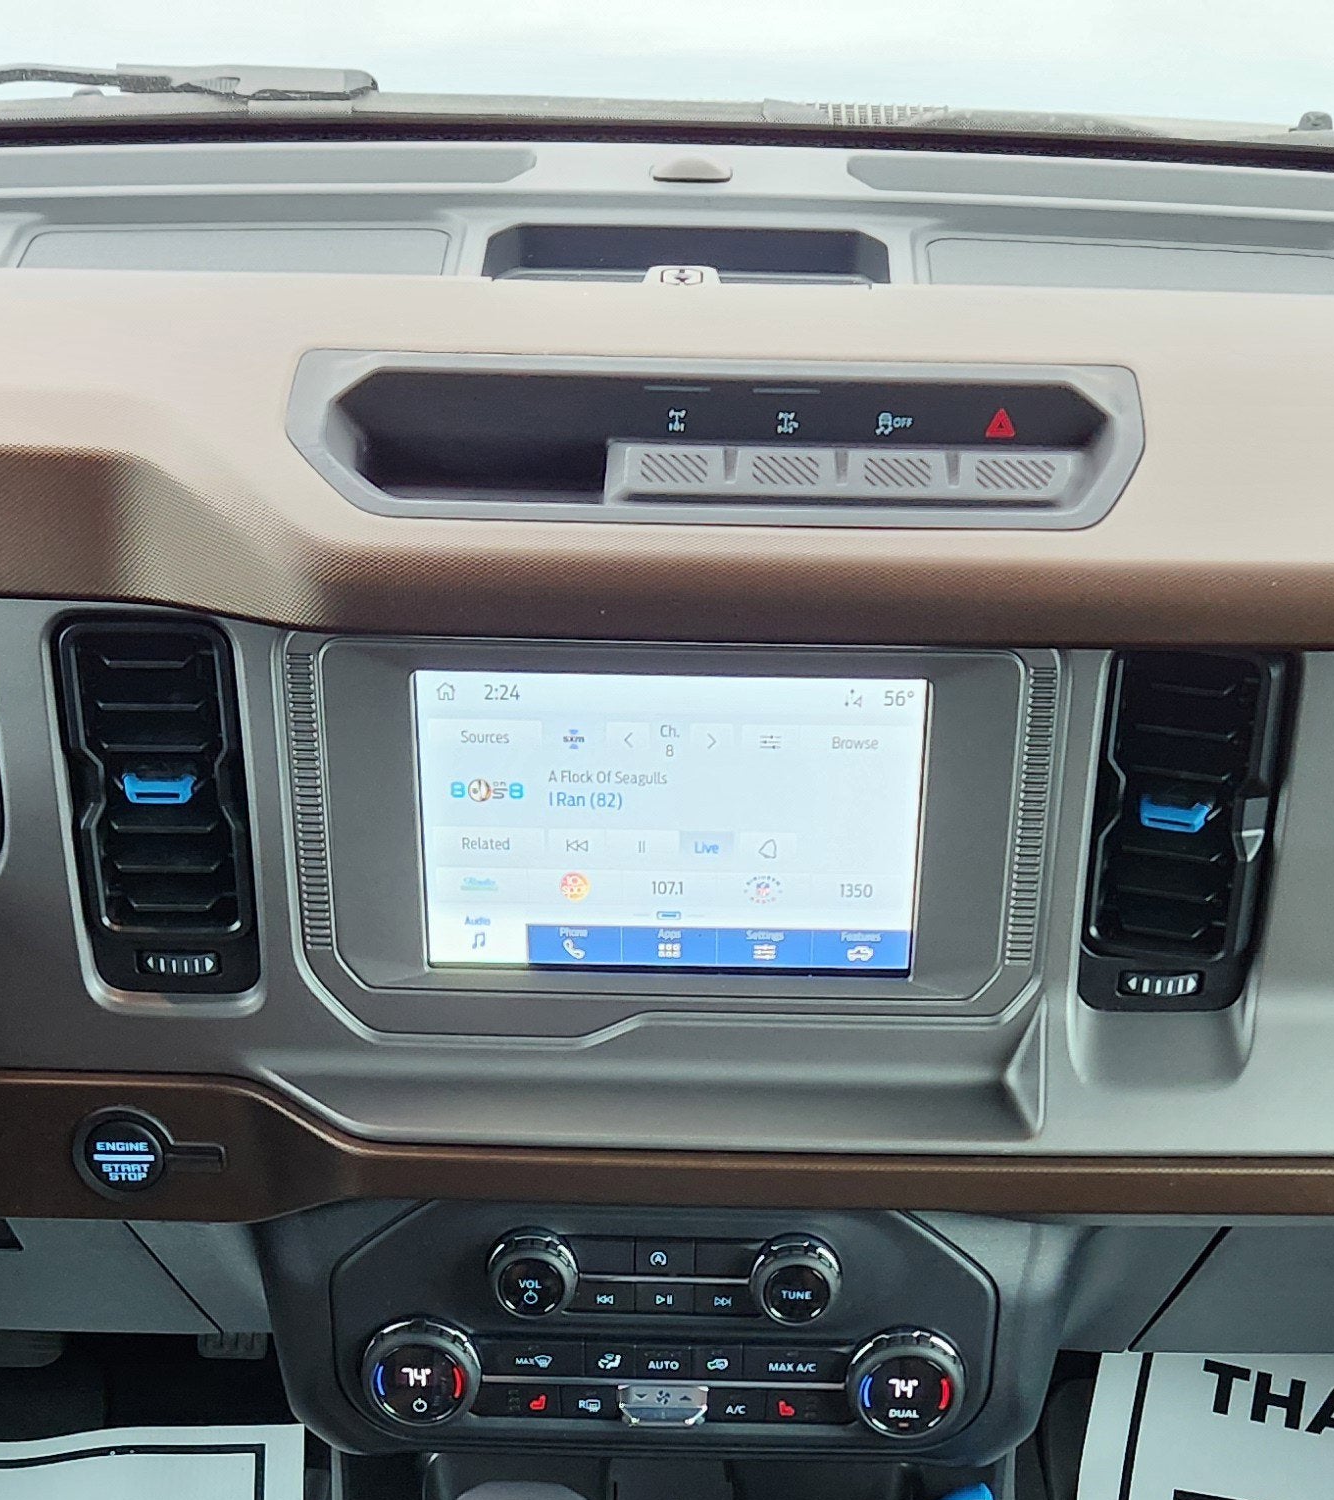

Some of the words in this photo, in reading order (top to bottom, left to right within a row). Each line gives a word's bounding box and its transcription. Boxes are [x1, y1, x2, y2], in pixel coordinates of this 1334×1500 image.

[893, 416, 914, 429] OFF
[484, 684, 520, 700] 2:24
[883, 690, 916, 707] 56°
[460, 730, 510, 745] Sources
[659, 724, 681, 739] Ch.
[831, 735, 880, 750] Browse
[665, 744, 675, 758] 8
[547, 770, 558, 783] A
[560, 770, 593, 784] Flock
[596, 770, 612, 784] Of
[614, 770, 667, 787] Seagulls
[556, 791, 585, 807] Ran
[590, 791, 623, 811] (82)
[461, 836, 511, 851] Related
[694, 841, 720, 855] Live
[651, 880, 685, 896] 107.1
[839, 883, 874, 899] 1350
[464, 915, 491, 926] Audio
[558, 926, 589, 938] Phone
[656, 928, 683, 941] Apps
[95, 1141, 149, 1152] ENGINE
[102, 1163, 150, 1173] START
[108, 1172, 147, 1182] STOP
[518, 1278, 542, 1289] VOL
[781, 1289, 813, 1301] TUNE
[515, 1357, 535, 1366] MAX
[647, 1360, 680, 1371] AUTO
[768, 1362, 793, 1374] MAX
[795, 1363, 817, 1374] A/C
[725, 1404, 747, 1416] A/C
[888, 1408, 920, 1420] DUAL
